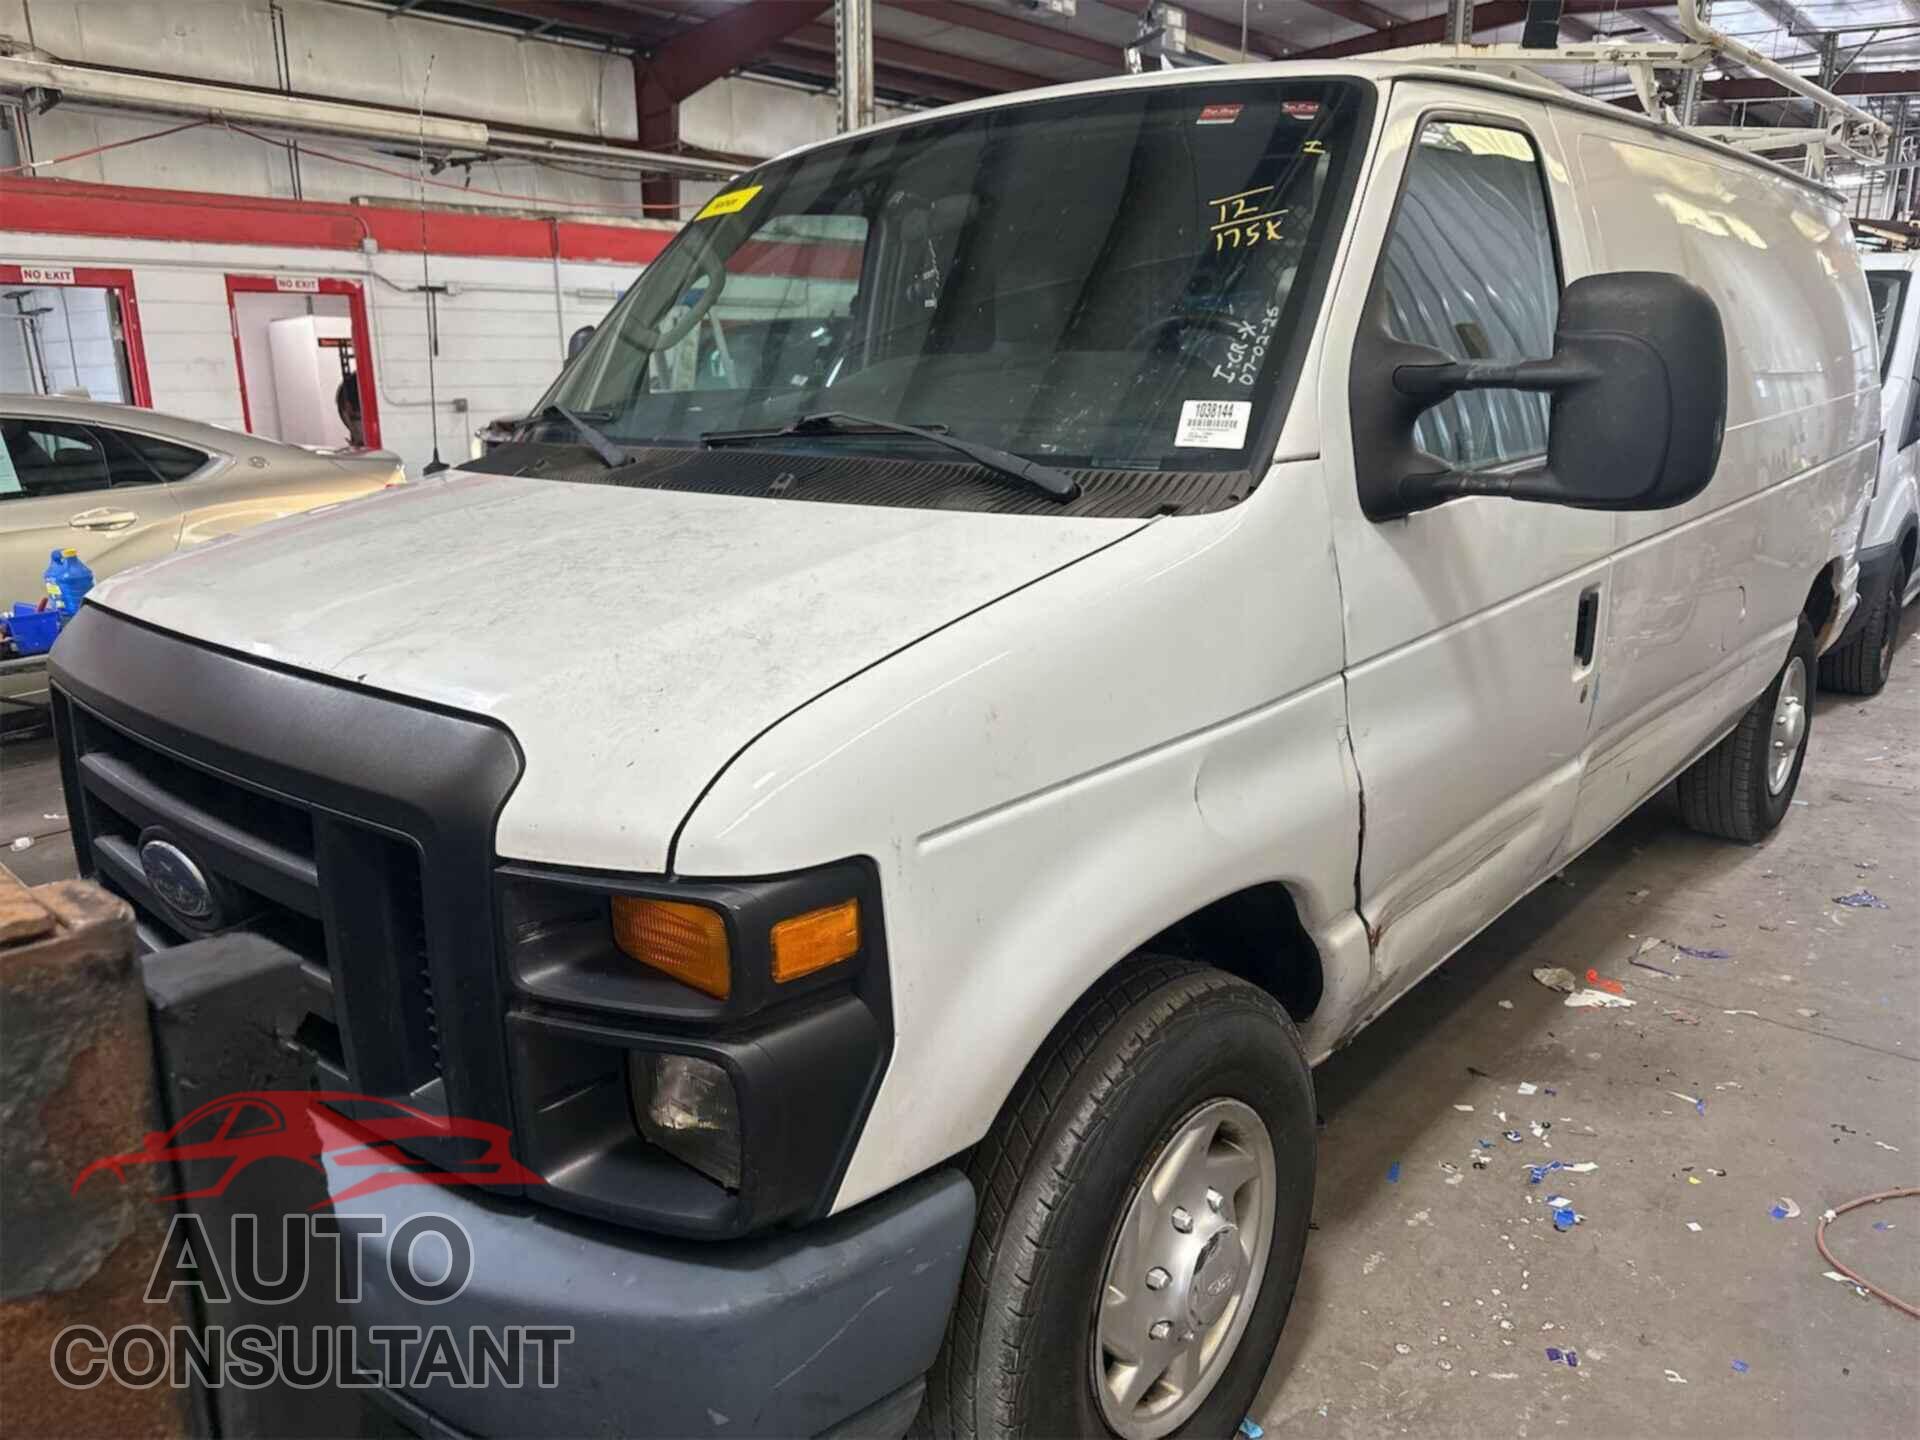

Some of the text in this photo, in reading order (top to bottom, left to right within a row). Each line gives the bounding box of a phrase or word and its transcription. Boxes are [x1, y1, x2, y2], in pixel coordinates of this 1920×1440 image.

[1220, 198, 1259, 223] 12
[23, 269, 71, 280] NO EXIT
[279, 279, 317, 289] NO EXIT
[1196, 403, 1234, 418] 1038144
